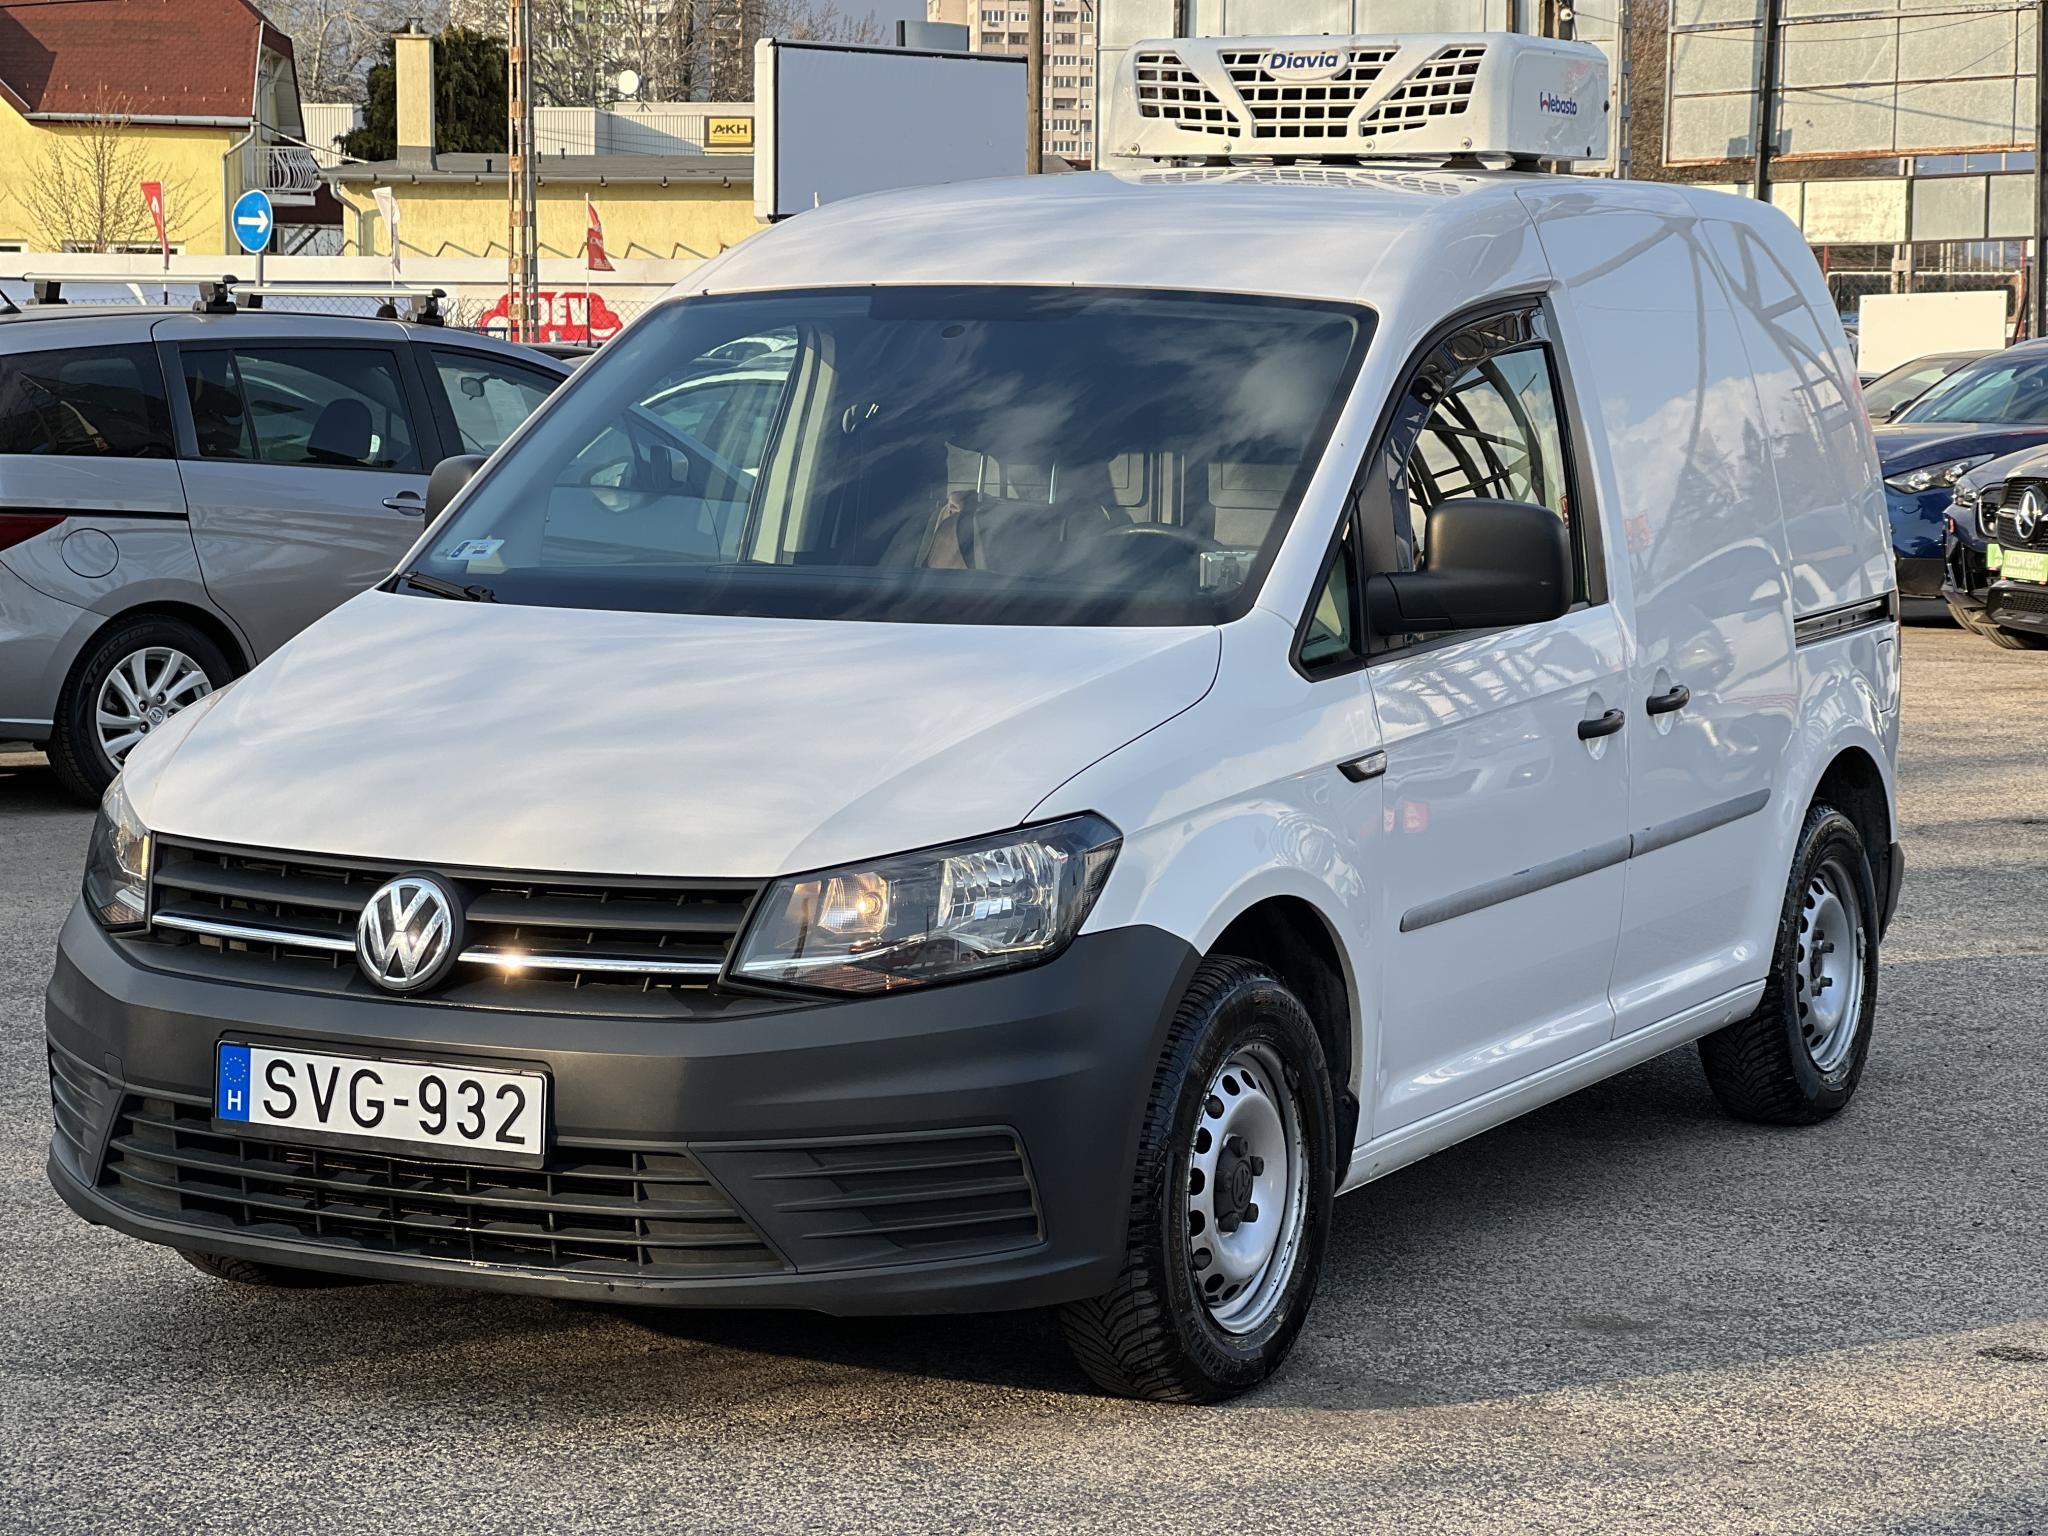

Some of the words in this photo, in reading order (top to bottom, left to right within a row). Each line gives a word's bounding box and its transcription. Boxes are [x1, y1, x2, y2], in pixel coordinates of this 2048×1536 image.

[1269, 51, 1339, 69] Diavia
[1539, 91, 1577, 115] Webasto
[712, 124, 748, 134] AKH
[227, 1089, 242, 1111] H
[263, 1058, 526, 1145] SVG-932
